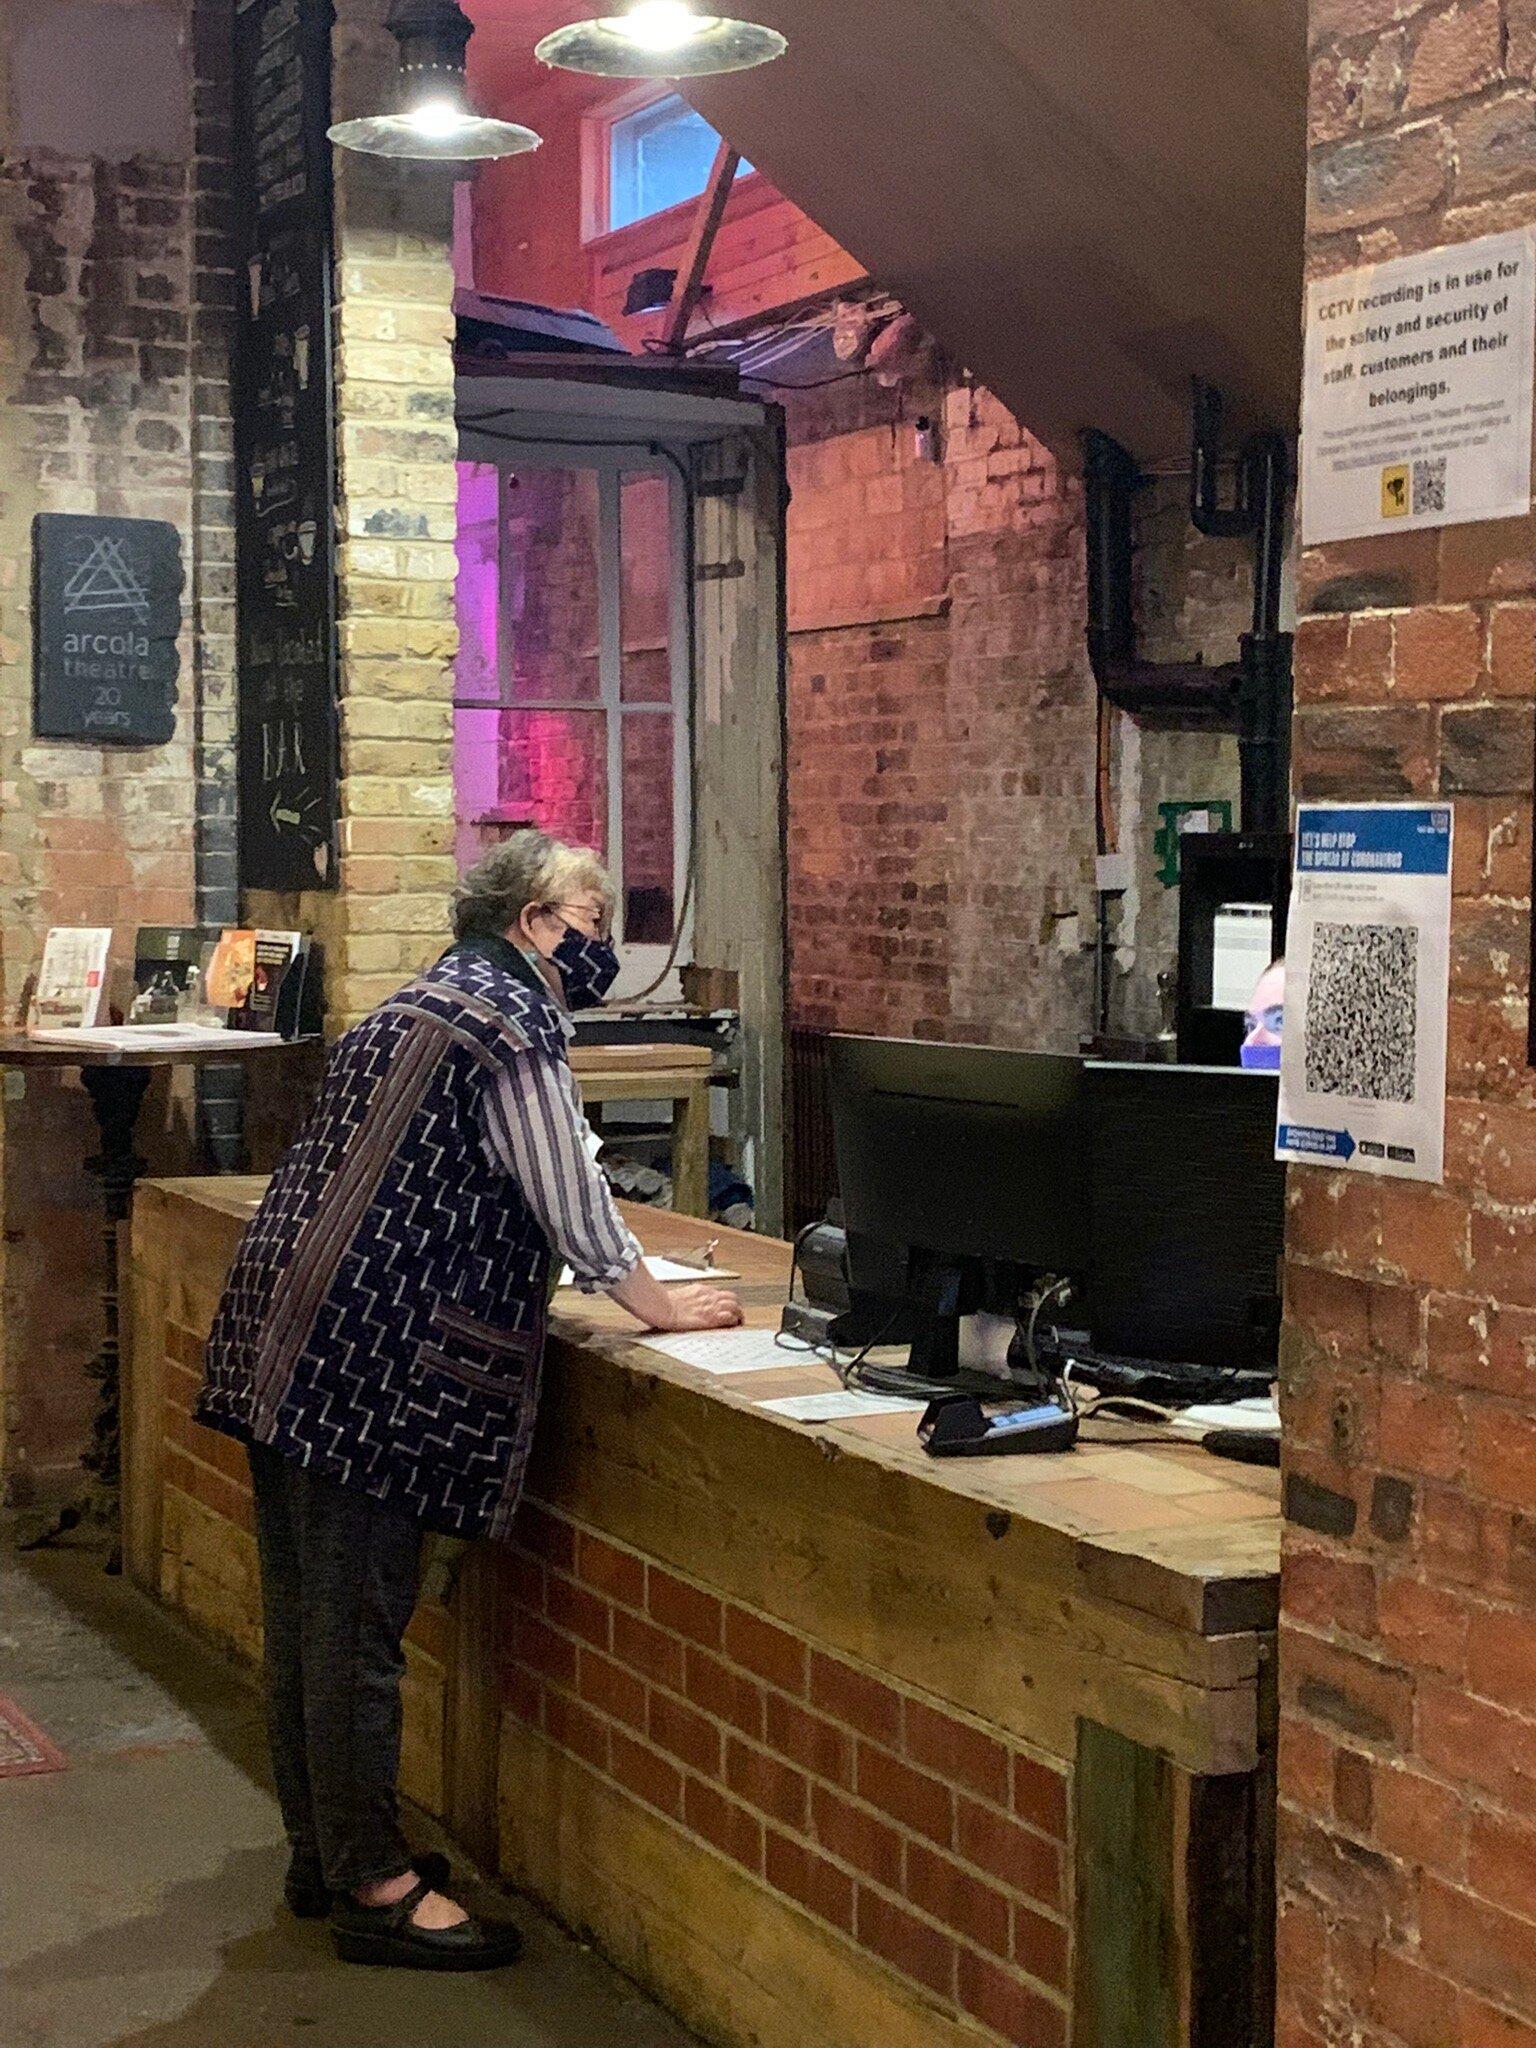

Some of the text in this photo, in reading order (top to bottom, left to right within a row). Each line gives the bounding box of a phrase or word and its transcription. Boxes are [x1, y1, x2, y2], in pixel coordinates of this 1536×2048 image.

[1318, 261, 1520, 321] CCTV recording is in use for
[1326, 294, 1509, 353] the safety and security of
[1360, 349, 1434, 377] customers
[1438, 338, 1467, 360] and
[1472, 331, 1509, 353] their
[63, 630, 150, 657] arcola
[64, 658, 152, 680] theatre
[94, 685, 122, 706] 20
[83, 711, 131, 728] years
